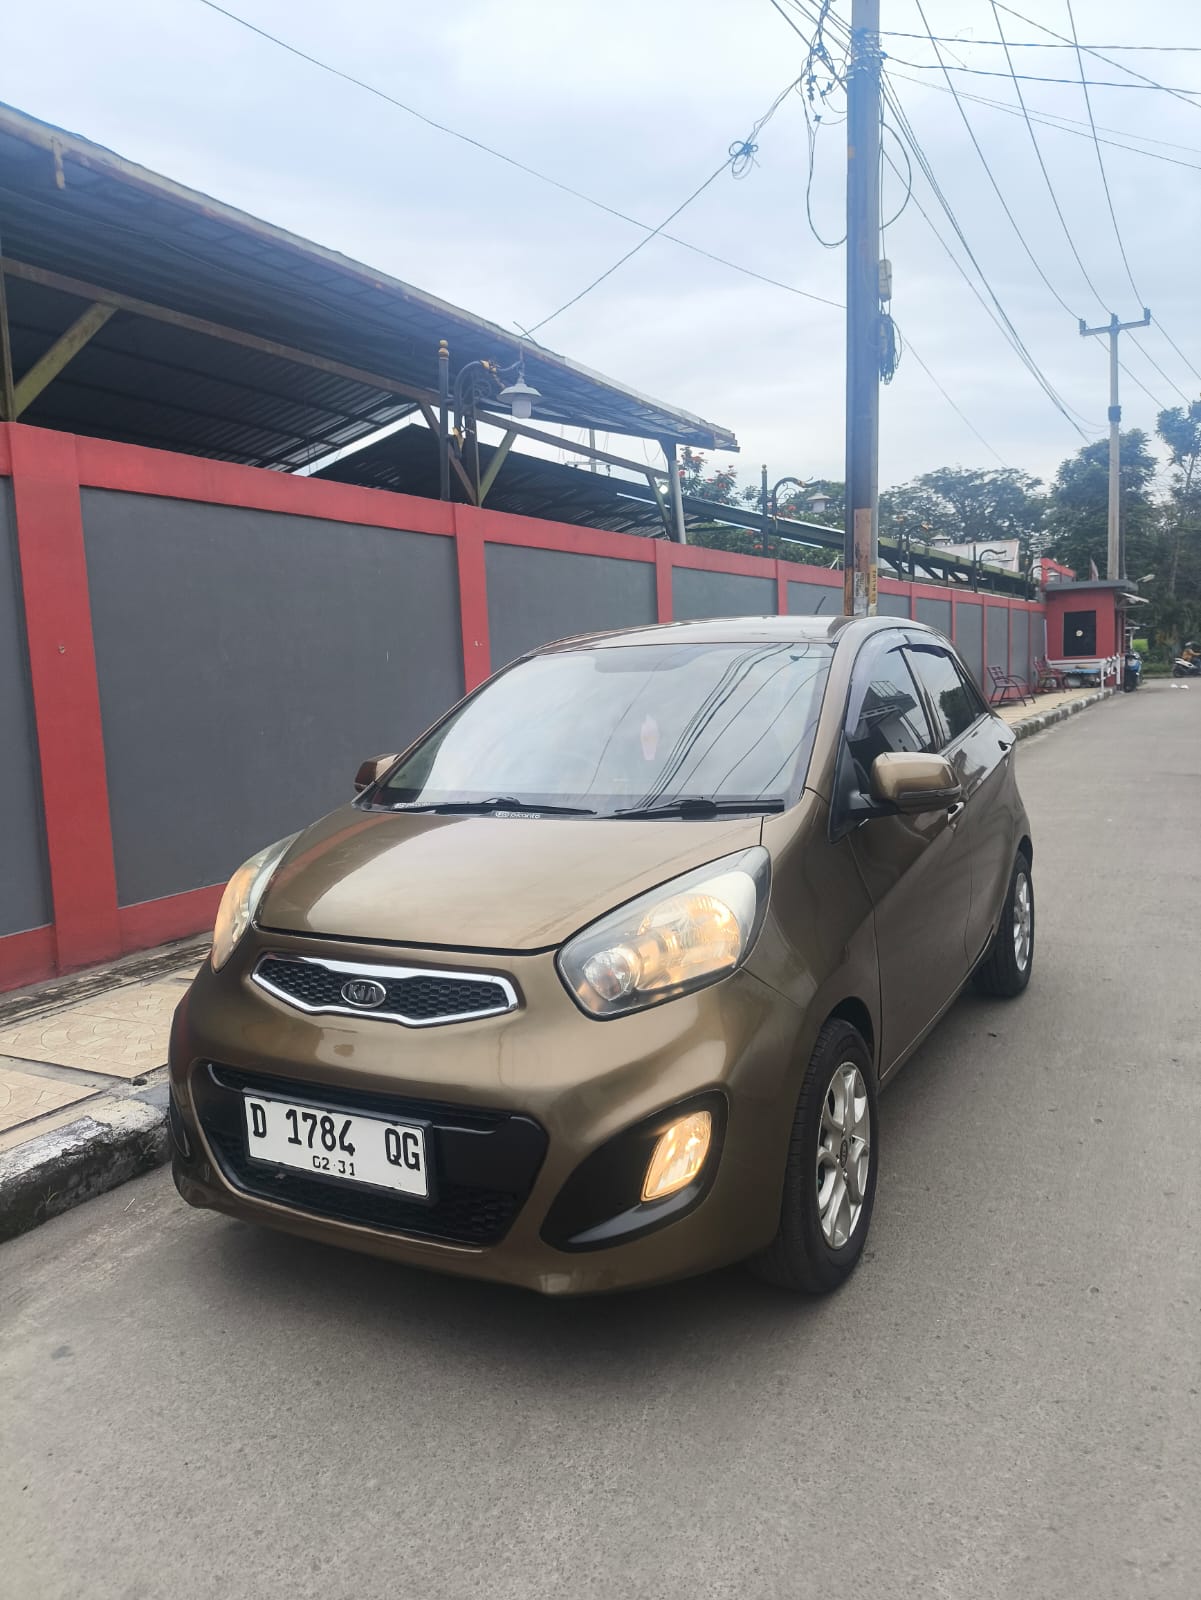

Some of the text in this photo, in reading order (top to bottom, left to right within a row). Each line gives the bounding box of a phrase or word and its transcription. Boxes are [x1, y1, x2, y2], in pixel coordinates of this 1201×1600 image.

[348, 984, 377, 1001] KIA
[250, 1103, 420, 1171] D 1784 QG
